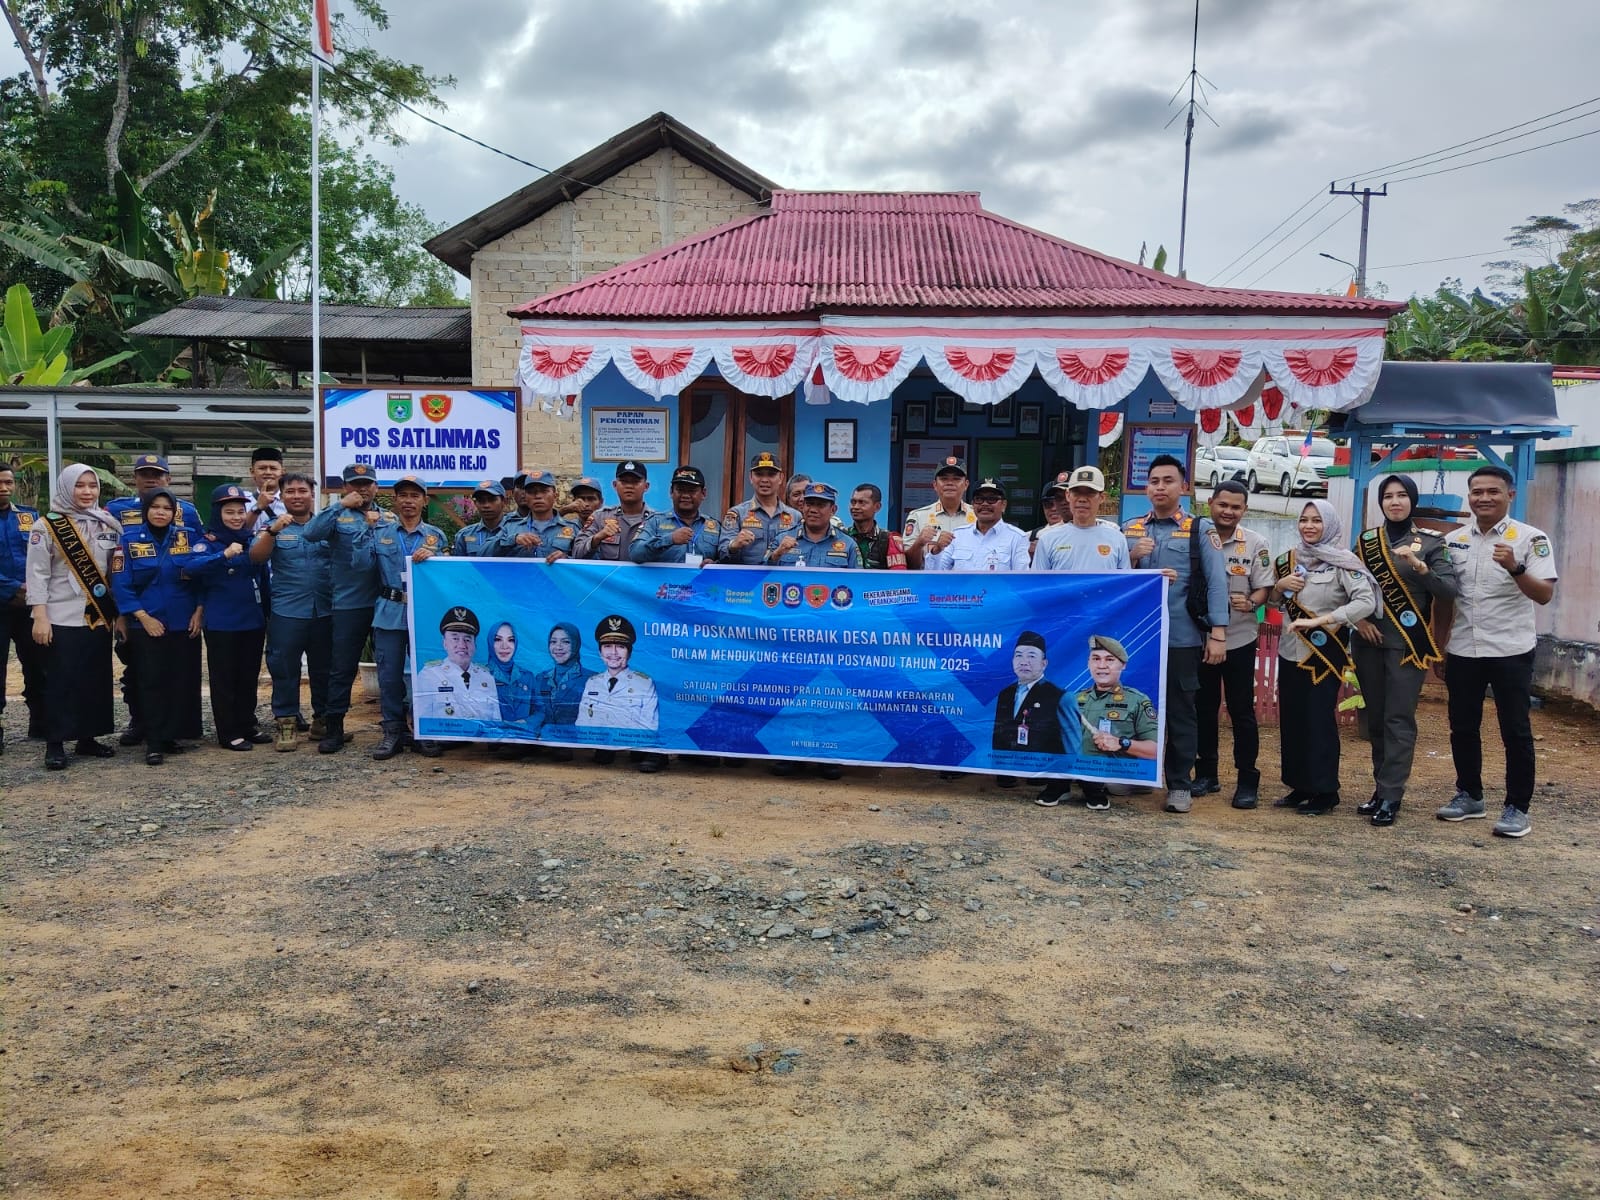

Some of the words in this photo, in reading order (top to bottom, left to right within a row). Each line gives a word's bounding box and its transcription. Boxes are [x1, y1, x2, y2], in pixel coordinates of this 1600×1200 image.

[341, 428, 380, 448] POS
[388, 428, 500, 449] SATLINMAS
[410, 454, 456, 470] KARANG
[459, 455, 487, 471] REJO
[53, 518, 79, 550] DUTA
[71, 548, 100, 586] PRAJA
[1365, 538, 1382, 571] DUTA
[1375, 569, 1407, 612] PRAJA
[644, 622, 689, 638] LOMBA
[693, 624, 777, 641] POSKAMLING
[782, 628, 838, 644] TERBAIK
[843, 630, 878, 646] DESA
[883, 631, 911, 647] DAN
[916, 632, 1002, 649] KELURAHAN
[671, 647, 707, 661] DALAM
[711, 649, 778, 664] MENDUKUNG
[782, 651, 834, 666] KEGIATAN
[838, 653, 896, 668] POSYANDU
[900, 656, 937, 670] TAHUN
[940, 657, 970, 672] 2025
[683, 680, 718, 691] SATUAN
[720, 682, 749, 692] POLISI
[752, 683, 790, 694] PAMONG
[793, 685, 821, 696] PRAJA
[824, 687, 843, 697] DAN
[846, 688, 893, 699] PEMADAM
[896, 690, 955, 702] KEBAKARAN
[675, 693, 708, 703] BIDANG
[710, 694, 745, 705] LINMAS
[748, 696, 766, 706] DAN
[769, 697, 807, 708] DAMKAR
[811, 699, 853, 710] PROVINSI
[856, 702, 918, 714] KALIMANTAN
[921, 704, 963, 716] SELATAN
[791, 740, 820, 748] OKTOBER
[821, 741, 838, 749] 2025
